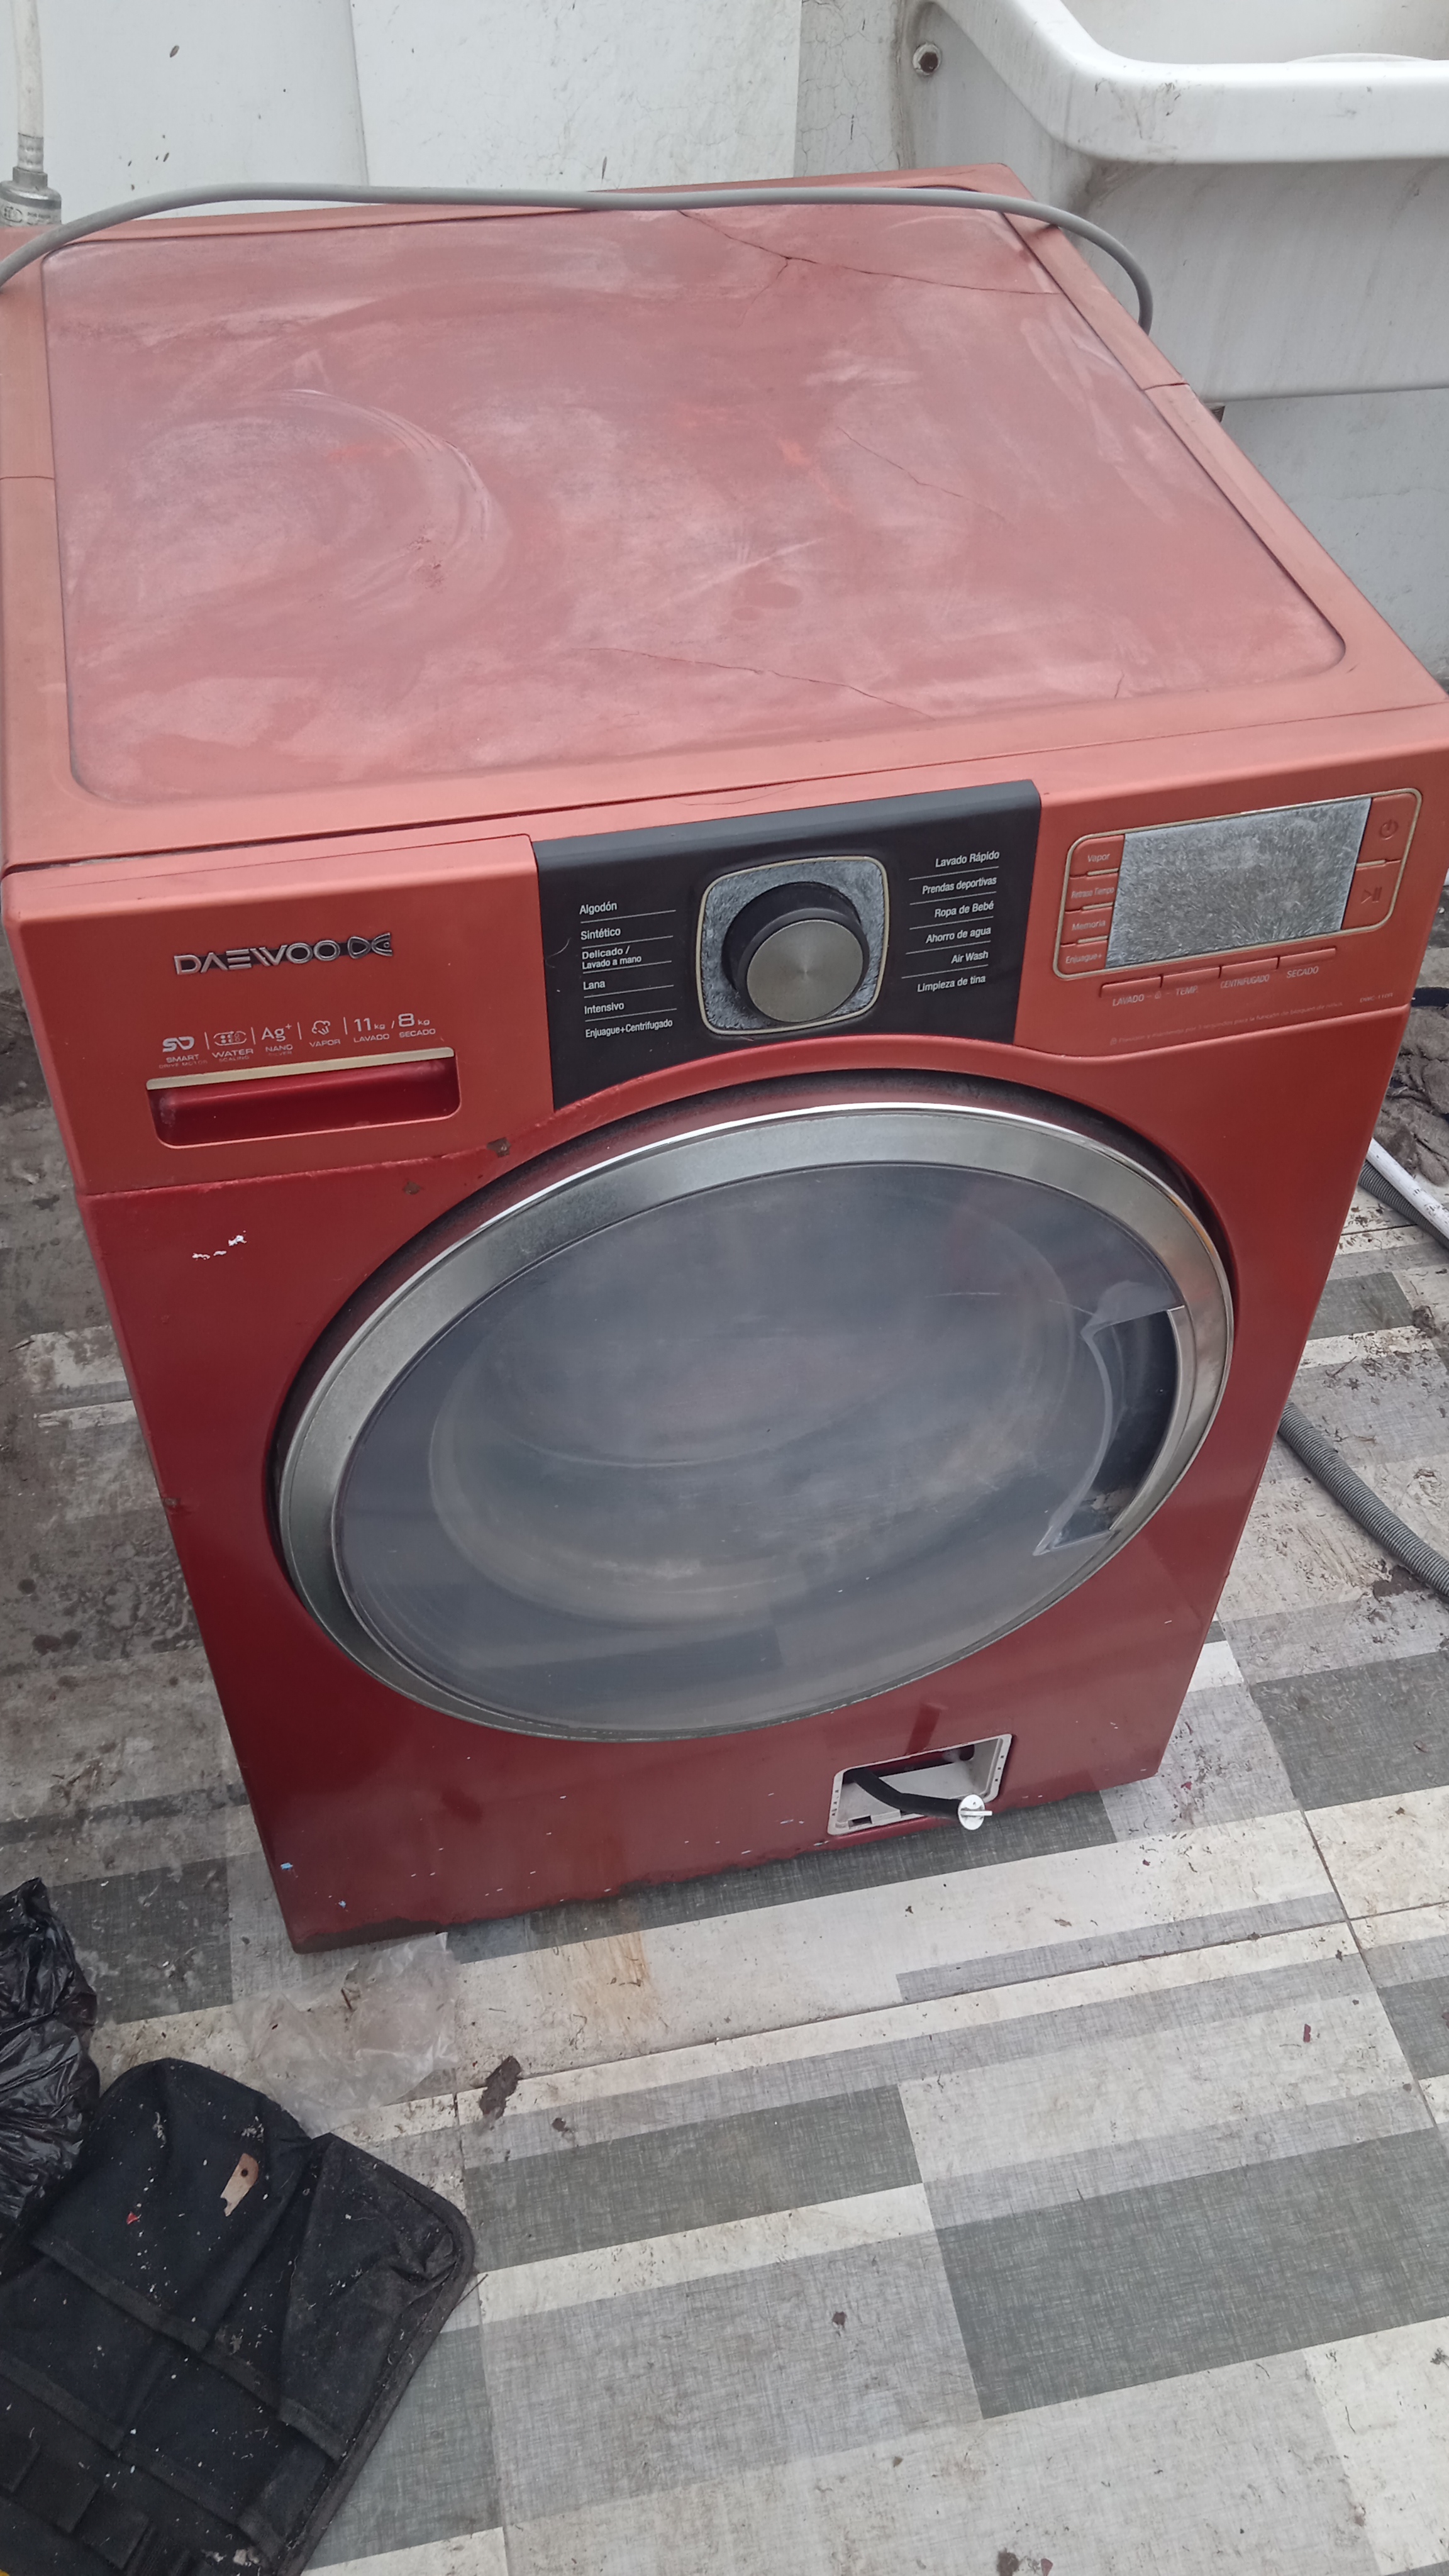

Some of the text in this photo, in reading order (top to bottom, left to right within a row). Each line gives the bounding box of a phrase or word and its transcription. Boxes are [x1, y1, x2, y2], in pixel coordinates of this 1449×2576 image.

[935, 850, 1000, 868] Lavado Rápido
[1087, 853, 1110, 862] Vapor
[922, 877, 997, 895] Prendas deportivas
[579, 901, 618, 915] Algodón
[935, 901, 994, 918] Ropa de Bebé
[1072, 919, 1106, 931] Memoria
[580, 928, 621, 940] Sintético
[925, 926, 991, 944] Ahorro de agua
[174, 940, 340, 975] DAEWOO
[582, 947, 623, 960] Delicado
[951, 950, 989, 964] Air Wash
[1065, 953, 1102, 964] Enjuague+
[582, 958, 611, 970] Lavado
[619, 955, 642, 965] mano
[1287, 966, 1319, 979] SECADO
[583, 980, 606, 991] Lana
[917, 975, 985, 992] Limpieza de tina
[1112, 994, 1145, 1006] LAVADO
[584, 1002, 625, 1014] Intensivo
[354, 1018, 371, 1032] 11
[398, 1013, 415, 1027] 8
[353, 1033, 390, 1043] LAVADO
[399, 1028, 436, 1038] SECADO
[265, 1044, 293, 1052] NANO
[309, 1039, 341, 1047] VAPOR
[166, 1054, 199, 1063] SMART
[212, 1048, 253, 1058] WATER
